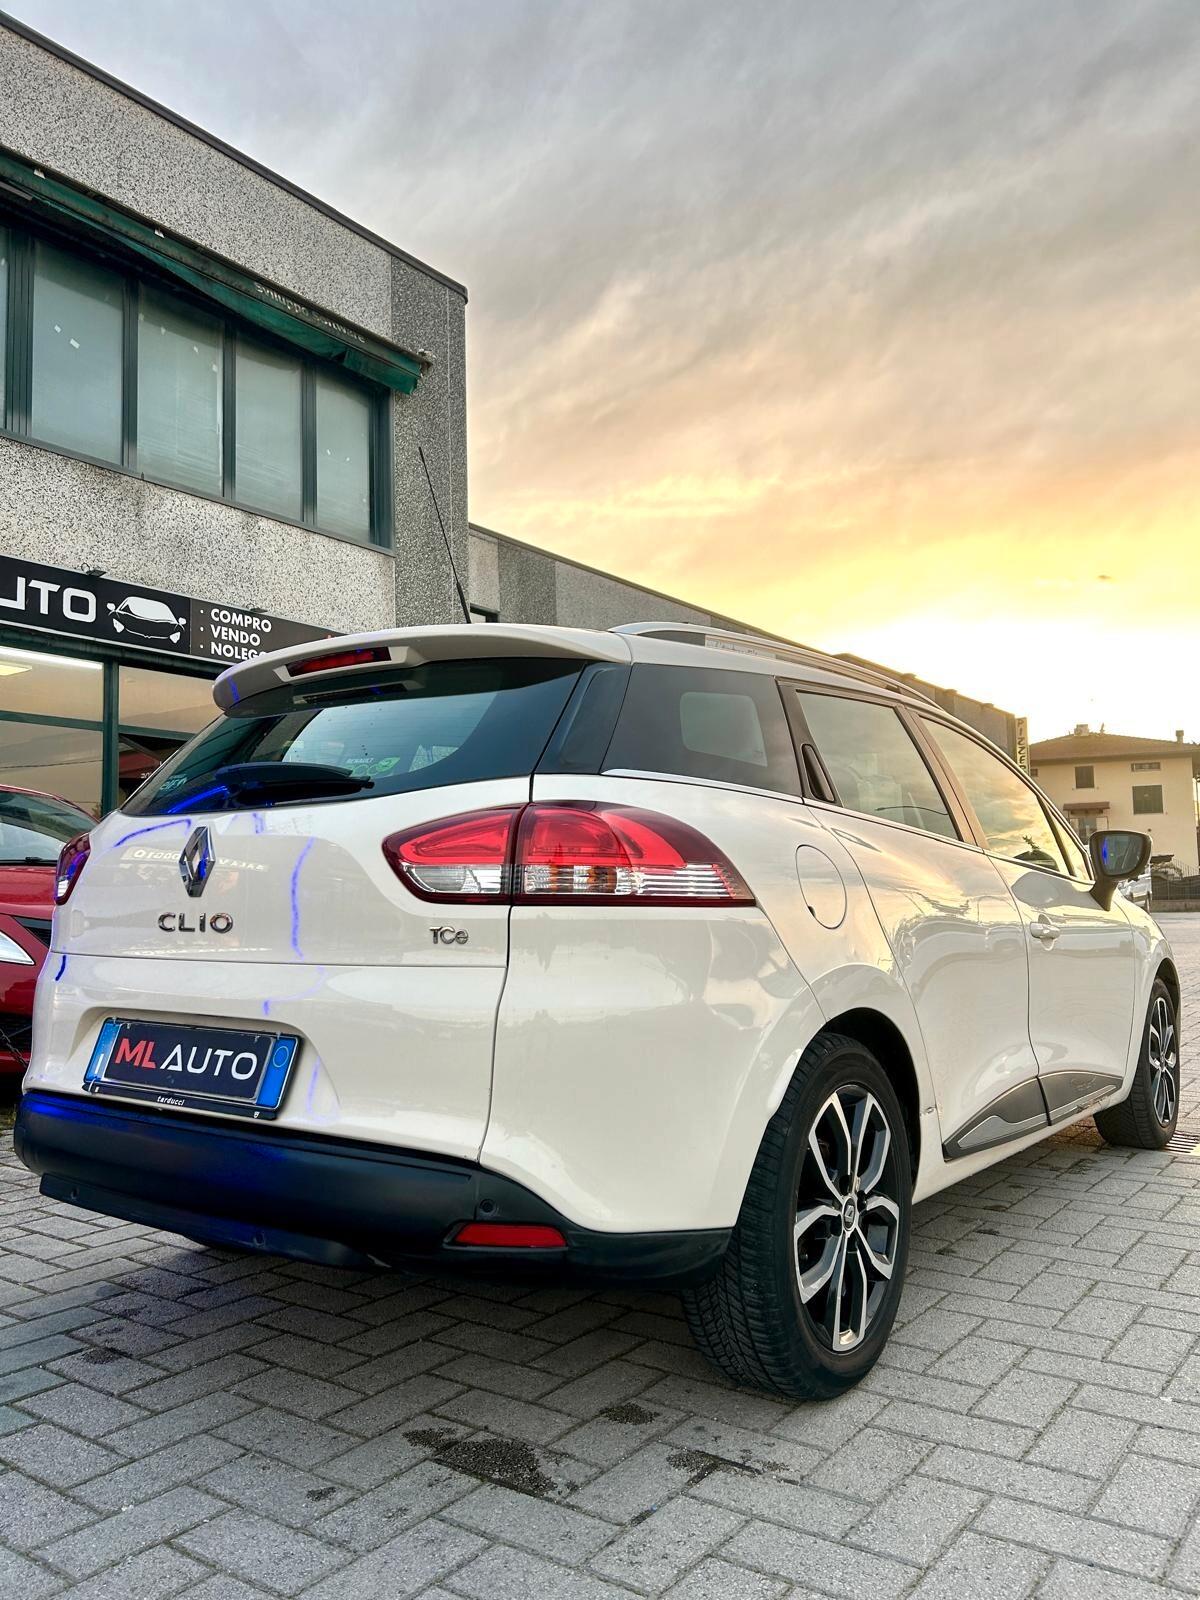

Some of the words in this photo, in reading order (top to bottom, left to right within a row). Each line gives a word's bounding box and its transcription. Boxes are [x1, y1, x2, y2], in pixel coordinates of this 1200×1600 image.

[211, 608, 272, 633] COMPRO
[210, 624, 261, 647] VENDO
[211, 641, 267, 660] NOLEG
[158, 912, 234, 934] CLIO
[429, 926, 469, 945] TCe
[115, 1038, 157, 1069] ML
[159, 1044, 258, 1081] AUTO
